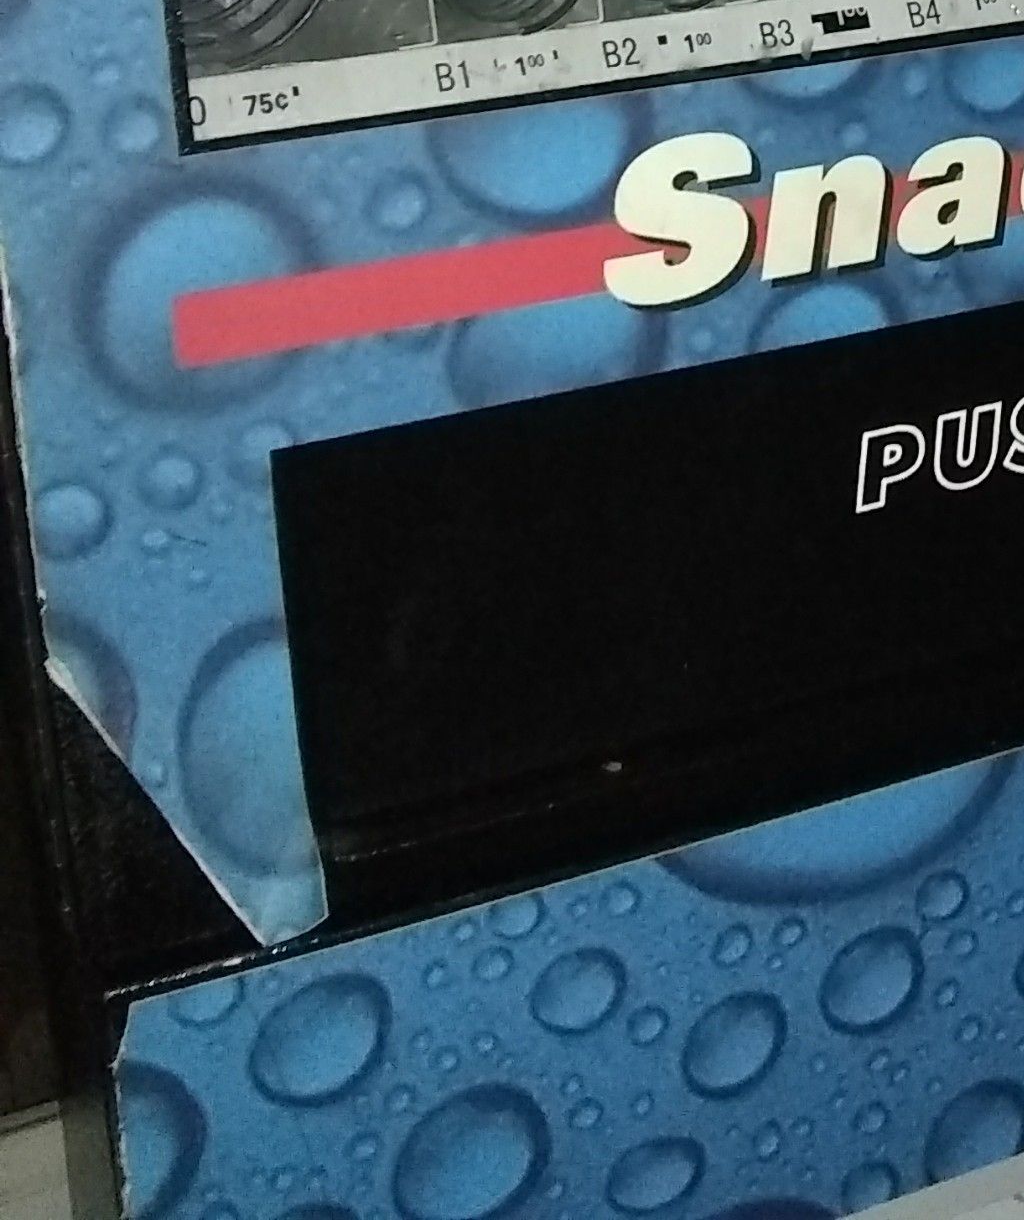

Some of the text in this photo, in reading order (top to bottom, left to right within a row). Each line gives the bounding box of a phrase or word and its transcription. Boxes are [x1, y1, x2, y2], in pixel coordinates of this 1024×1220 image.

[759, 20, 795, 50] B3
[602, 37, 641, 69] B2
[435, 61, 471, 92] B1
